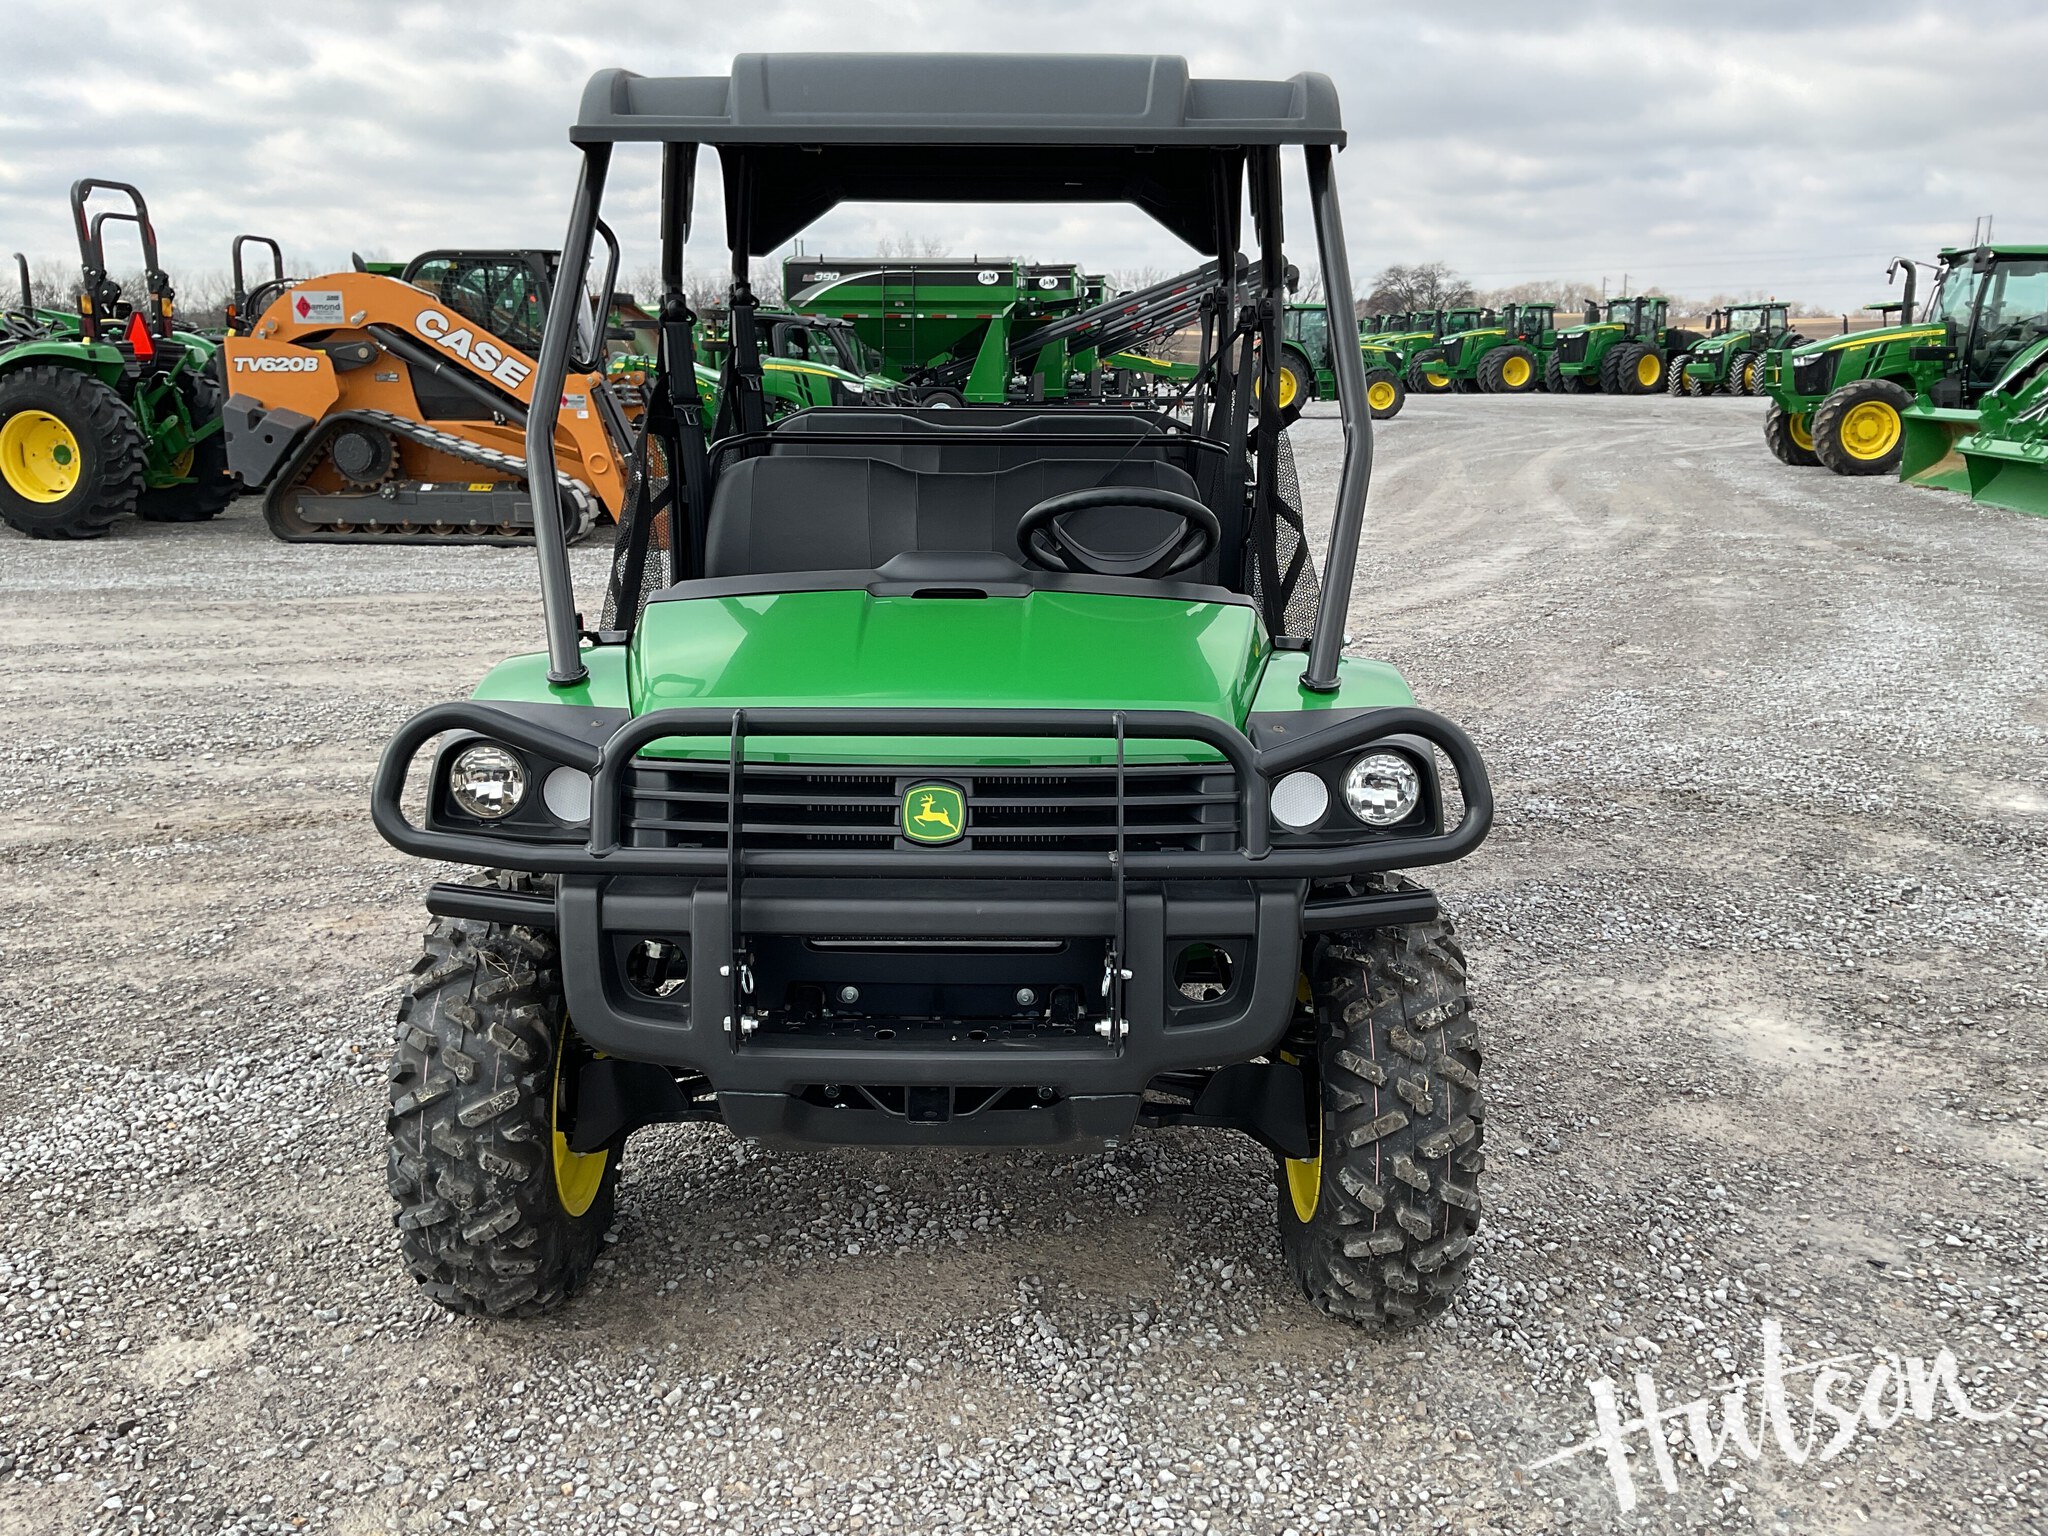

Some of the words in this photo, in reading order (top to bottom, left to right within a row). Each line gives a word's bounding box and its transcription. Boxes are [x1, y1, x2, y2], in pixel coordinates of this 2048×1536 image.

[814, 271, 841, 281] 390
[415, 309, 533, 390] CASE
[233, 356, 319, 372] TV620B
